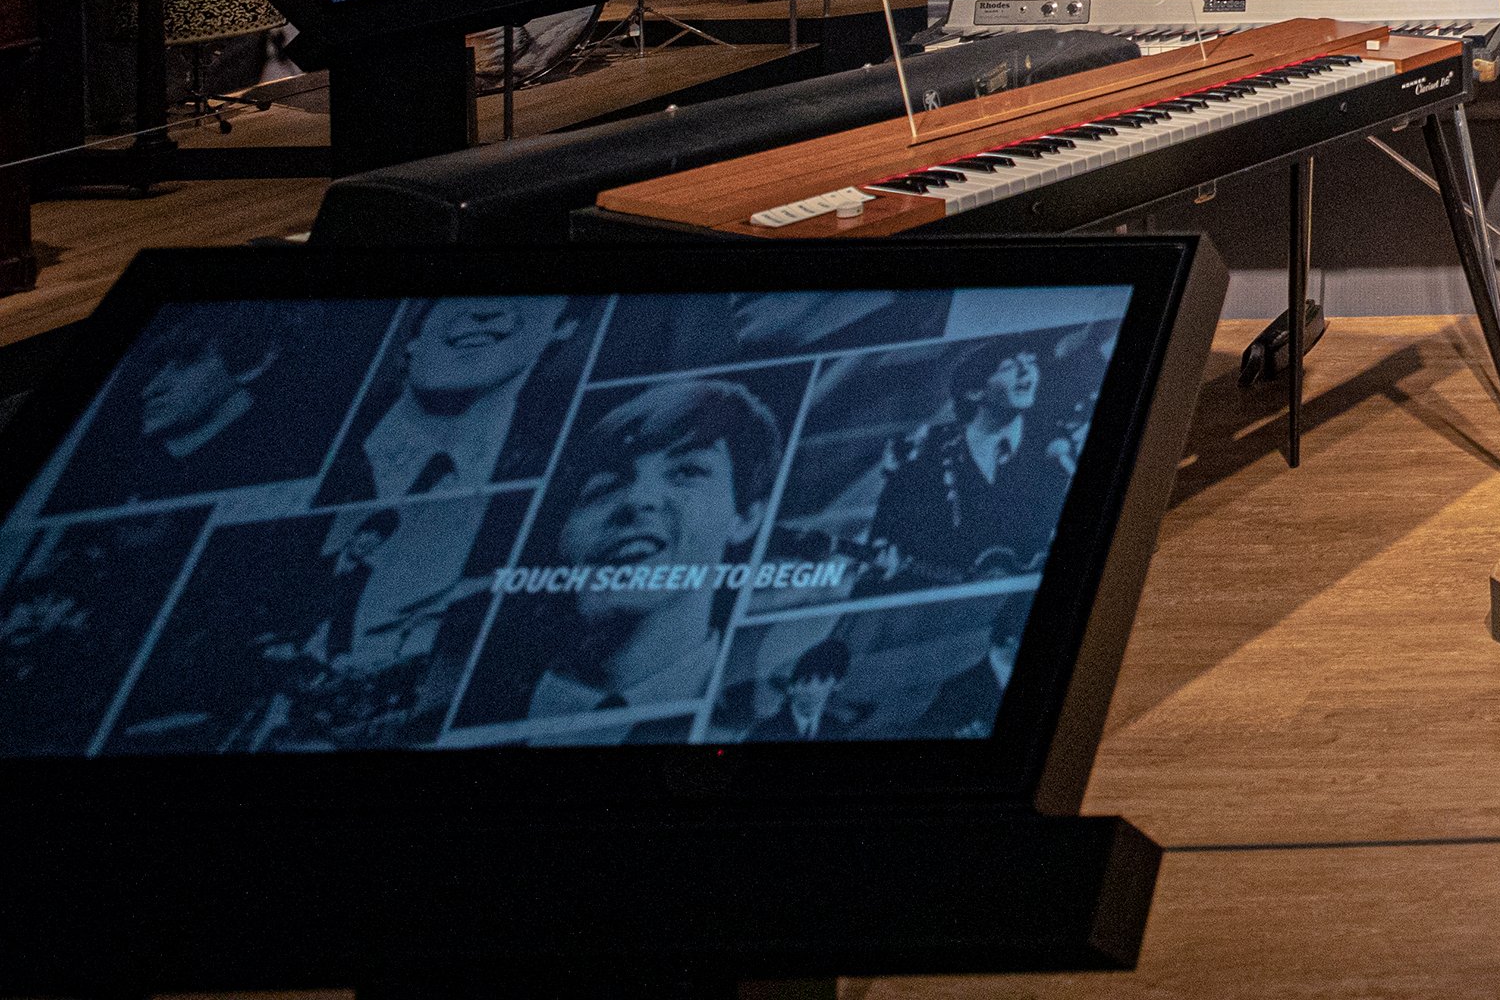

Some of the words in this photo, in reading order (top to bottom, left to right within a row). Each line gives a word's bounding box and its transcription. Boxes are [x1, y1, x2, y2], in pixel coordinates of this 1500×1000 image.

[979, 1, 1011, 9] Rhodes
[493, 566, 589, 593] TOUCH
[590, 563, 707, 592] SCREEN
[711, 562, 749, 589] TO
[752, 561, 847, 588] BEGIN
